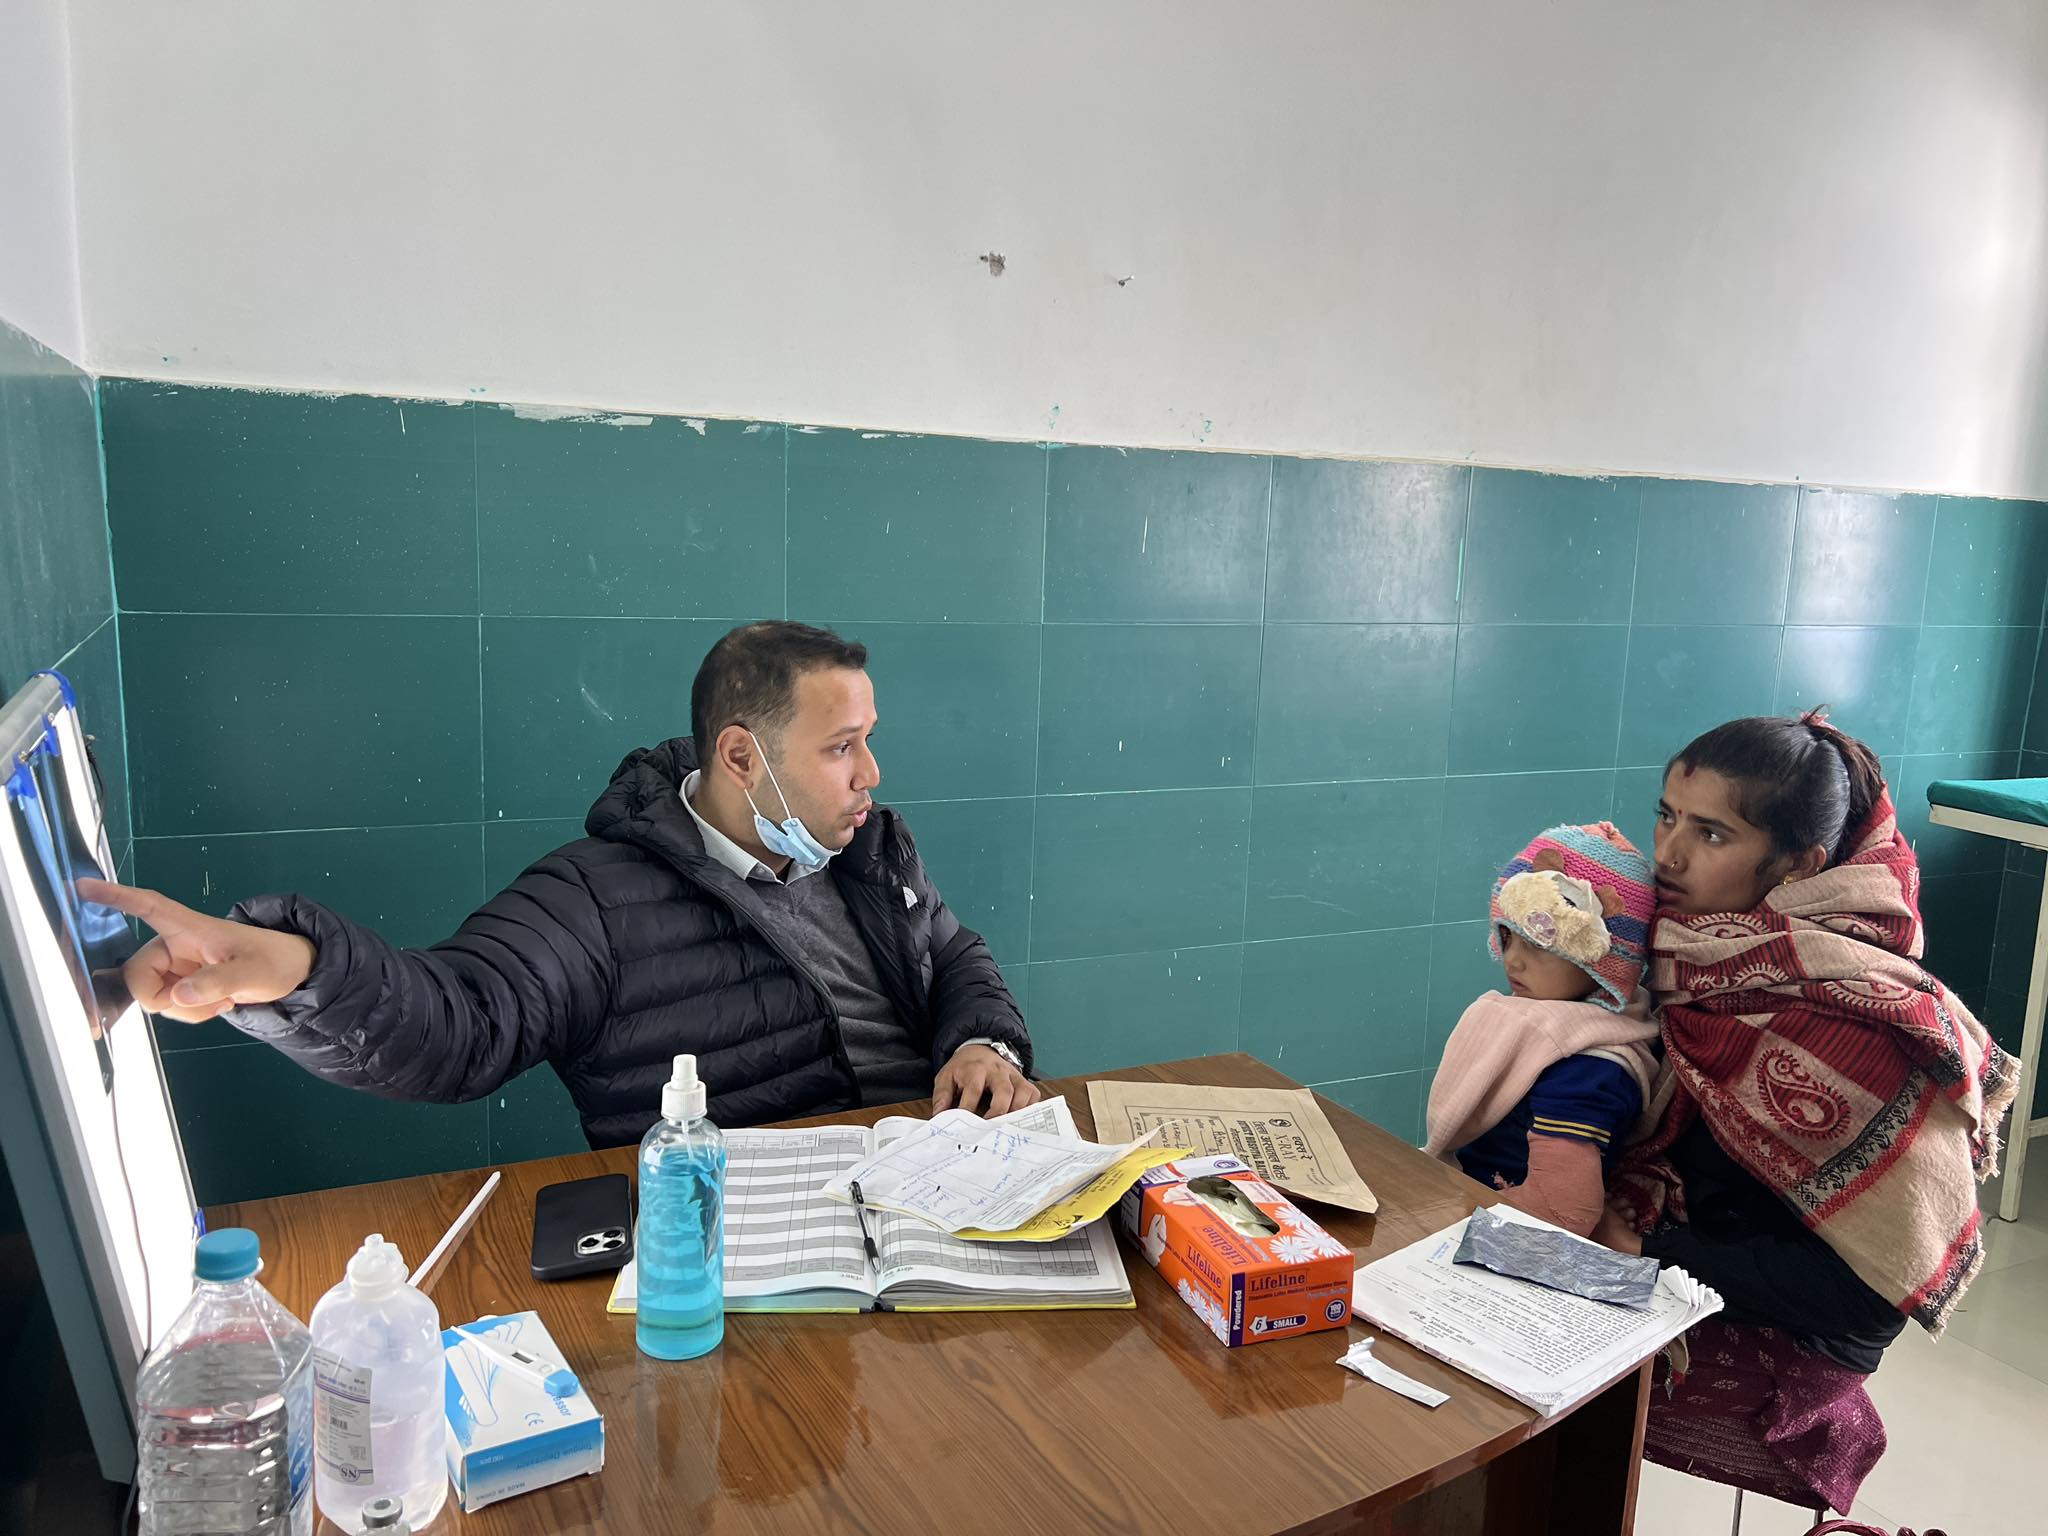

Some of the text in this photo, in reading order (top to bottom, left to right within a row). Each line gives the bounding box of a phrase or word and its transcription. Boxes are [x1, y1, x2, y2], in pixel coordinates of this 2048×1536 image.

[1261, 1135, 1280, 1163] अस्पताल
[1274, 1134, 1299, 1161] X-RAY
[1203, 1227, 1247, 1265] Lifeline
[1187, 1246, 1222, 1288] Lifeline
[1251, 1274, 1305, 1292] Lifeline
[1233, 1290, 1242, 1330] Powdered
[1256, 1317, 1298, 1330] 6 SMALL
